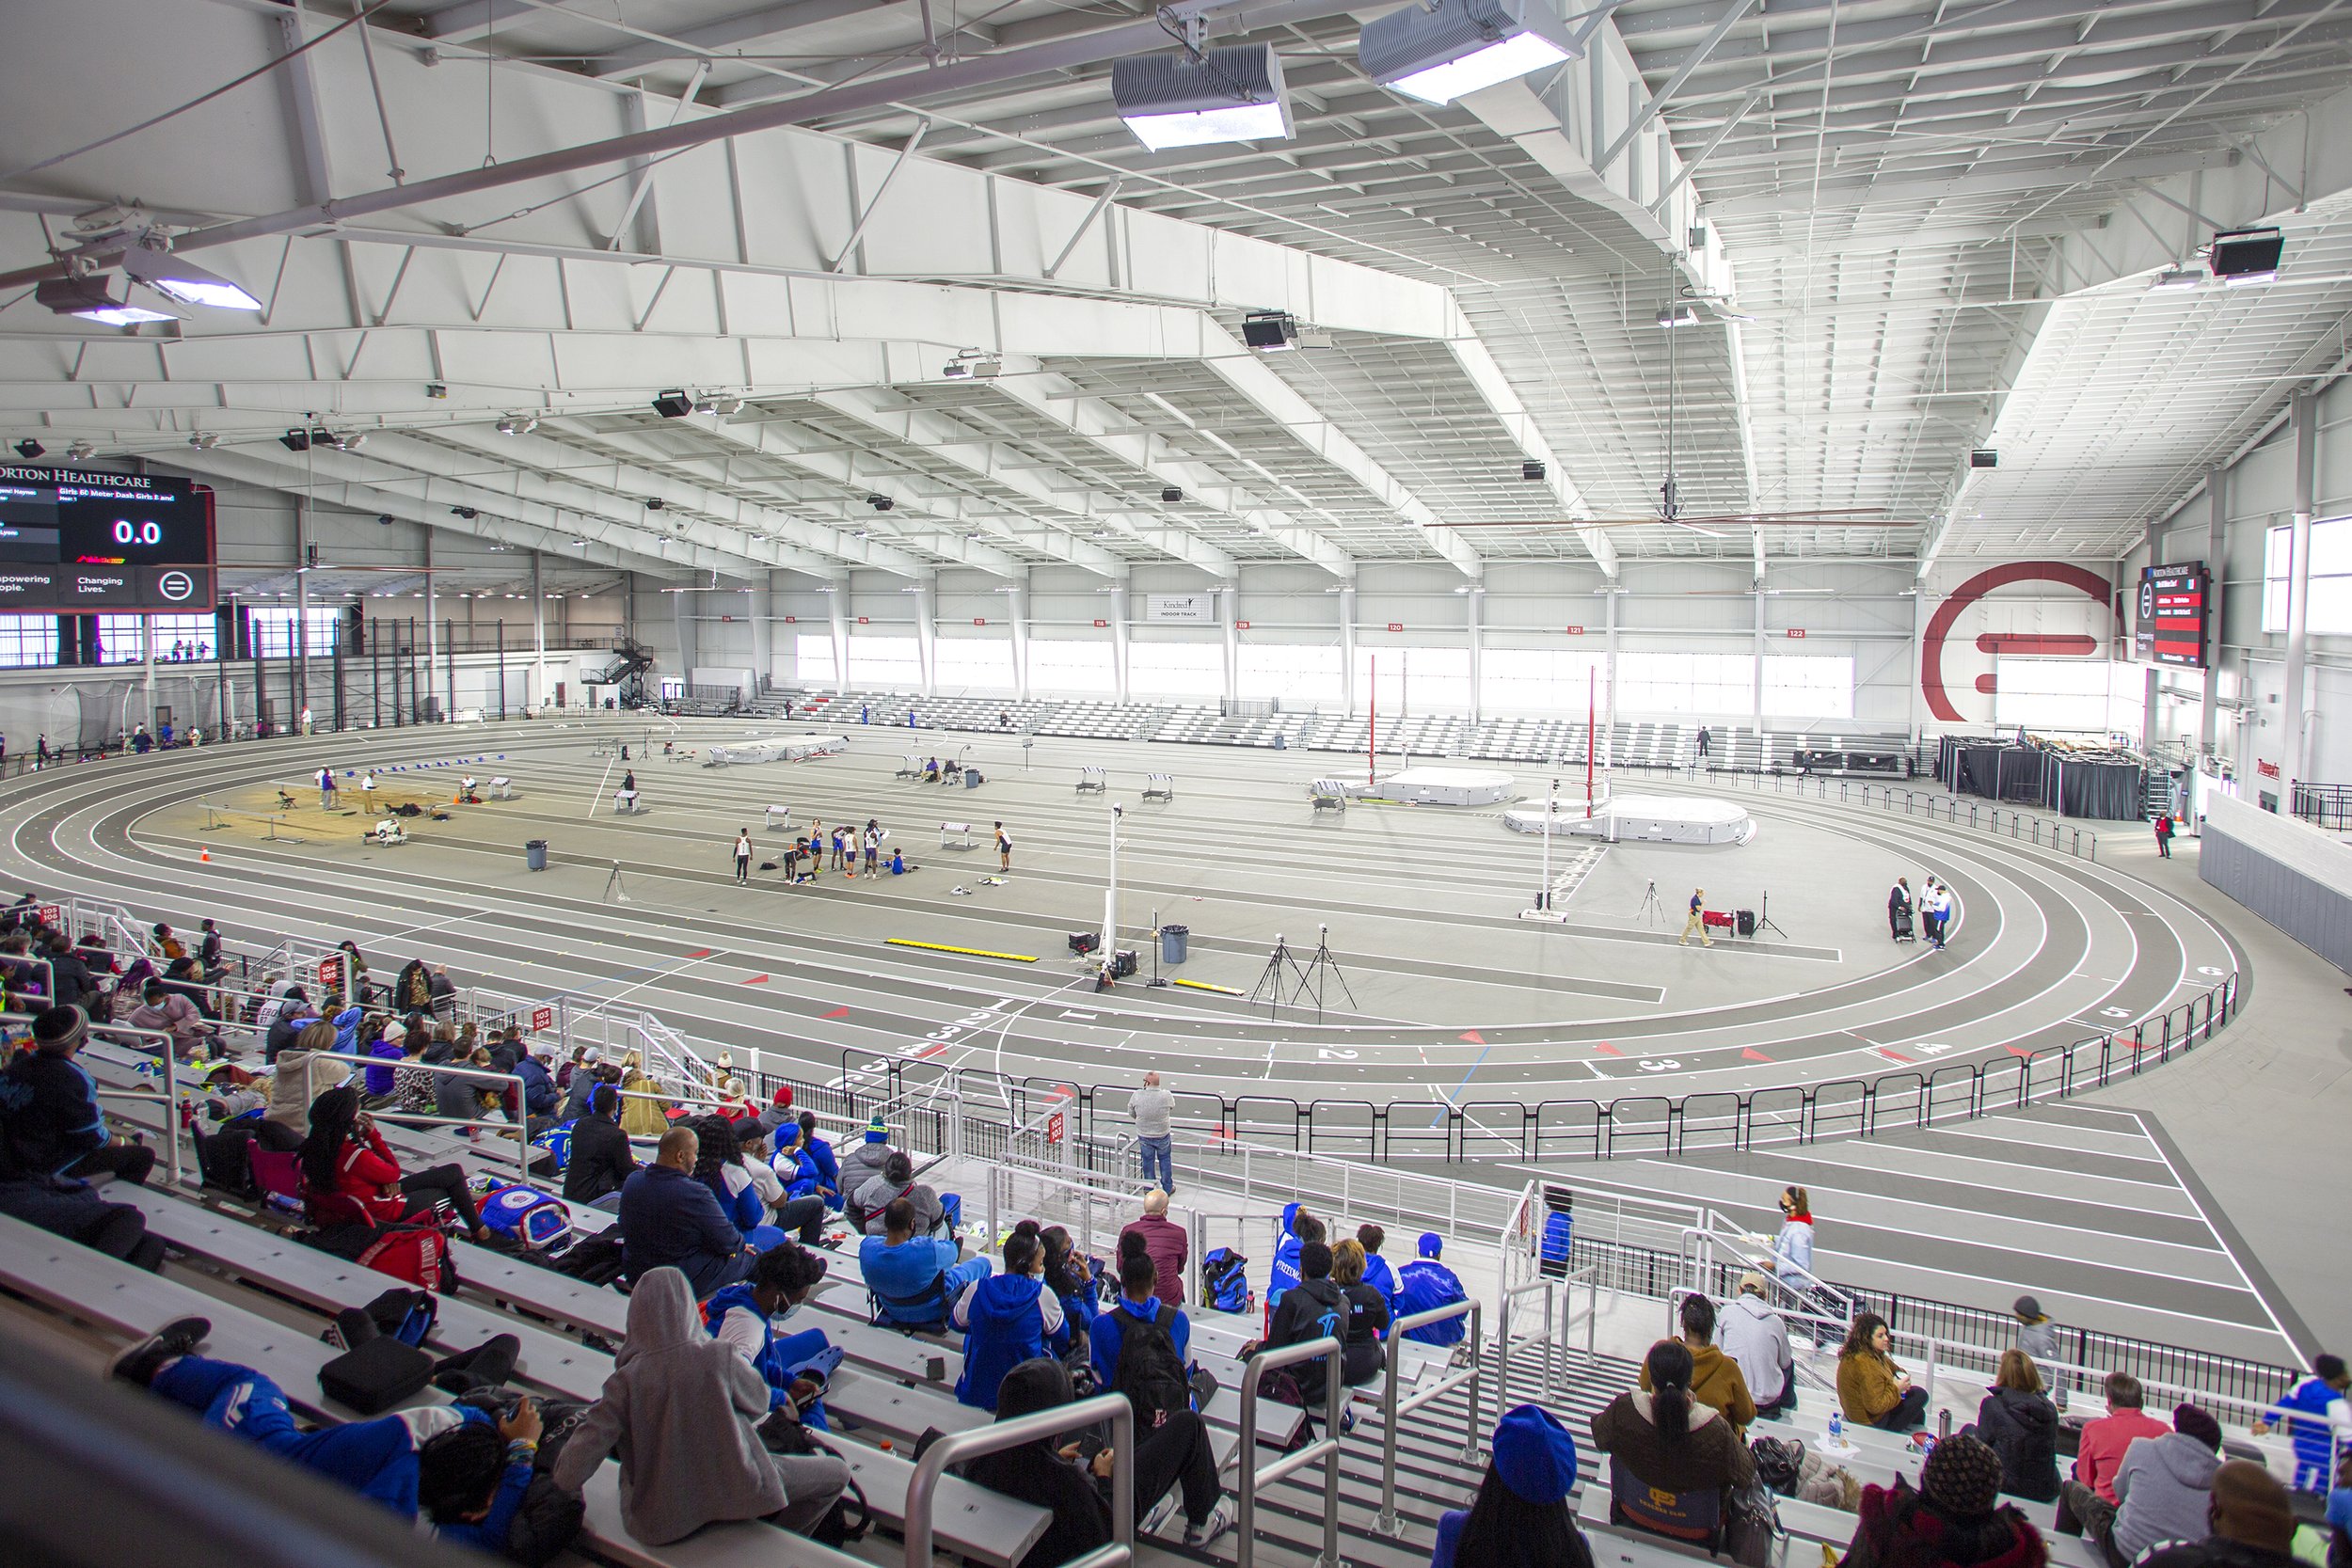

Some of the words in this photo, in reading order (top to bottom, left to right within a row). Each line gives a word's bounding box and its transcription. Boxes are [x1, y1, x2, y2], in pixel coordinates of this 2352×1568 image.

[58, 487, 78, 496] Girls
[115, 491, 135, 499] Dash
[114, 520, 162, 544] 0.0
[78, 577, 123, 586] Changing
[322, 964, 337, 973] 104
[2197, 966, 2224, 975] 6
[323, 972, 337, 980] 105
[981, 998, 1014, 1011] 1
[535, 1010, 549, 1021] 103
[954, 1011, 991, 1025] 2
[2100, 1006, 2134, 1018] 5
[536, 1019, 549, 1028] 104
[926, 1025, 961, 1039] 3
[897, 1042, 932, 1056] 4
[1914, 1043, 1953, 1053] 4
[1318, 1049, 1359, 1060] 2
[860, 1057, 899, 1072] 5
[1639, 1059, 1681, 1071] 3
[1051, 1117, 1062, 1130] 102
[1051, 1126, 1062, 1139] 103
